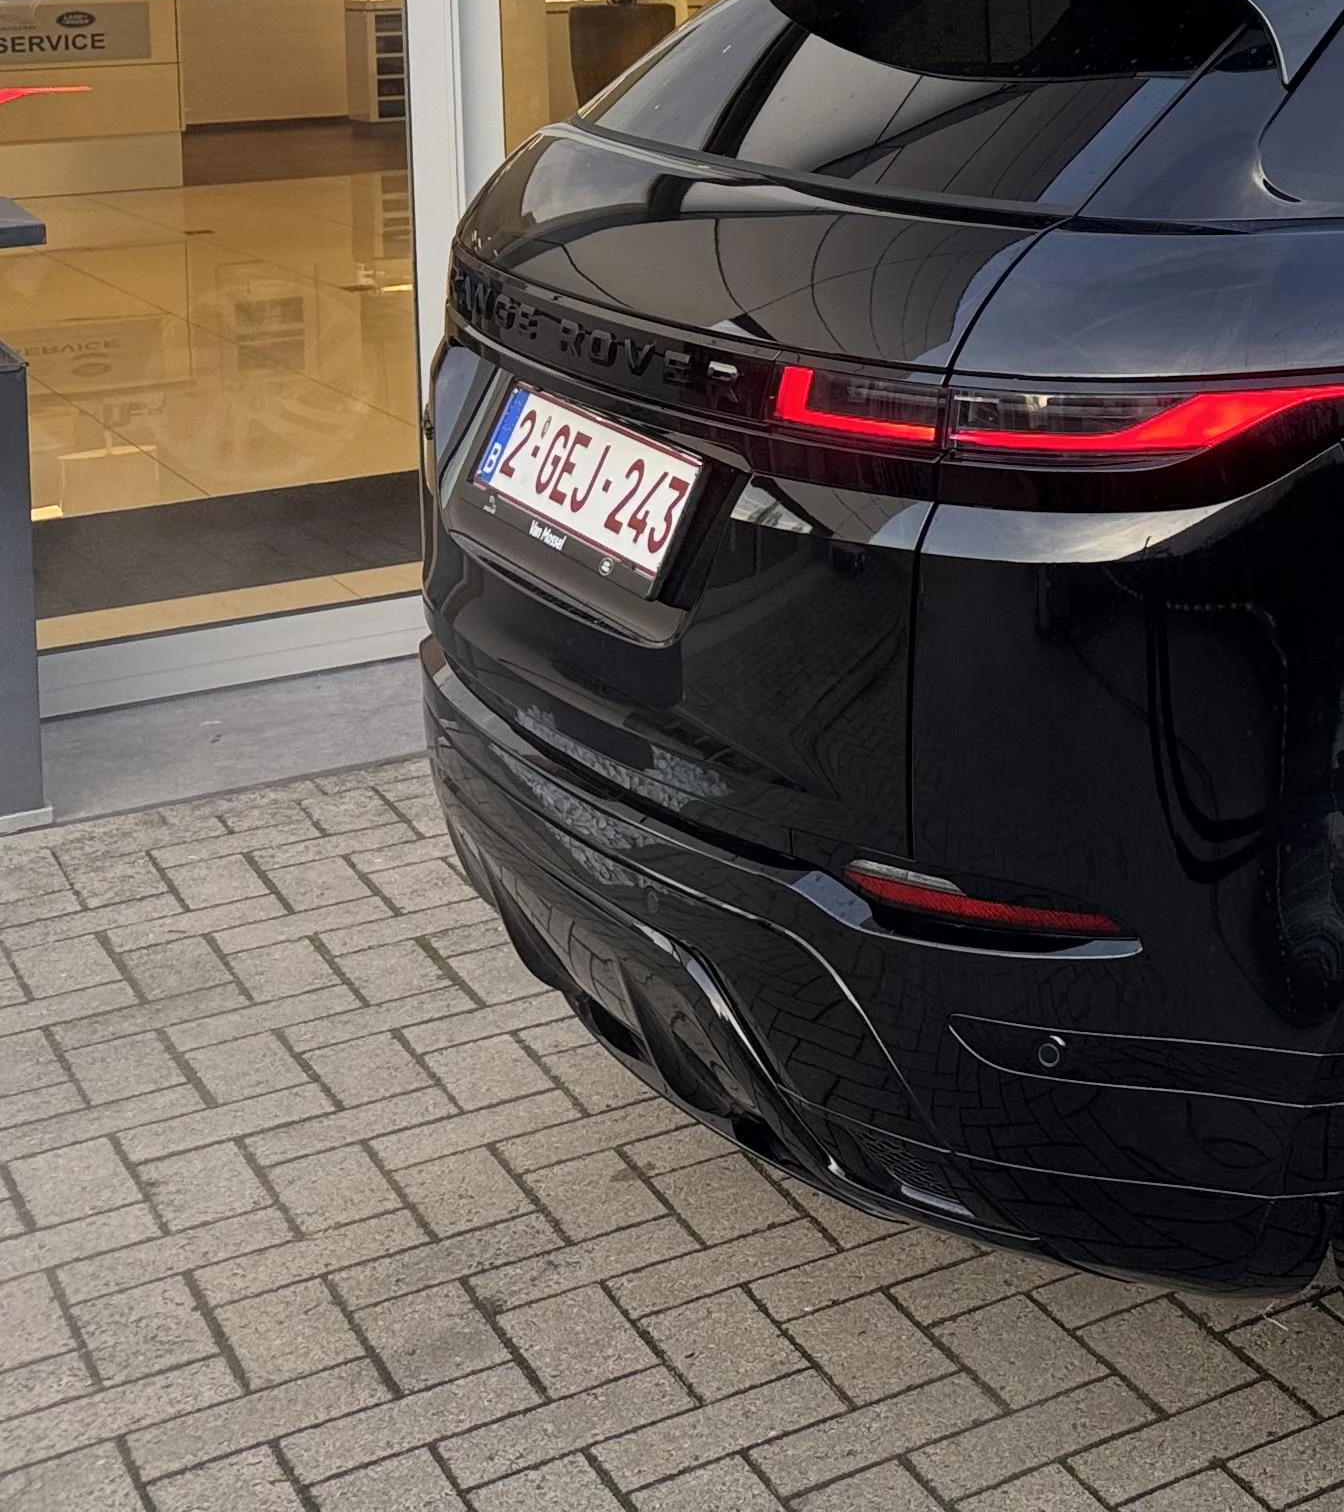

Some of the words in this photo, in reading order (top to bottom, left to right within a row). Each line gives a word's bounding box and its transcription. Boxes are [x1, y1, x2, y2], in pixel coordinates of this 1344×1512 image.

[559, 317, 746, 405] ROVER
[483, 442, 502, 473] B
[499, 408, 690, 554] 2-GEJ-243
[528, 519, 543, 539] Van
[539, 528, 568, 552] Mossel
